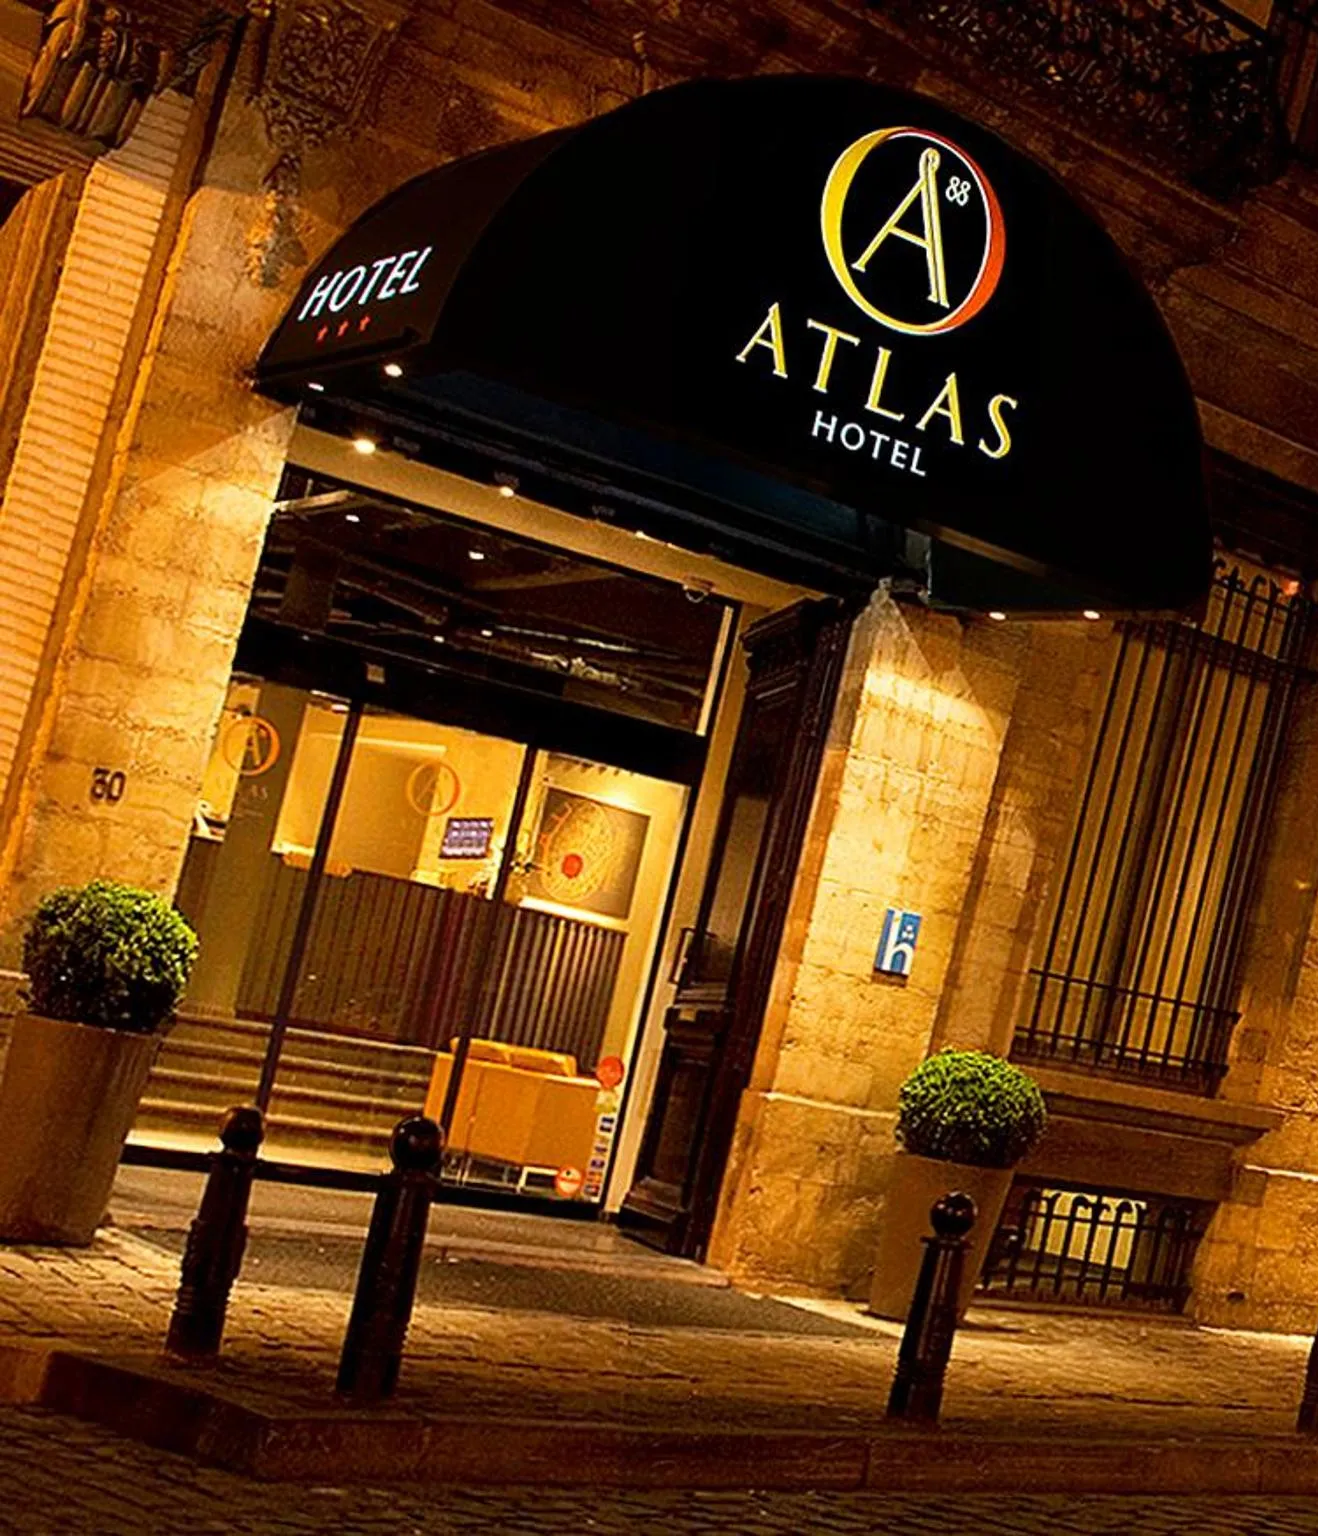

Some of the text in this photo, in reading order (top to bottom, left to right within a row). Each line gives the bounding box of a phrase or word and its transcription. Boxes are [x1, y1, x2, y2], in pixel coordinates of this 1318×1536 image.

[851, 146, 949, 308] A
[298, 246, 433, 321] HOTEL
[735, 302, 1018, 459] ATLAS
[811, 410, 927, 477] HOTEL
[90, 766, 127, 802] 30
